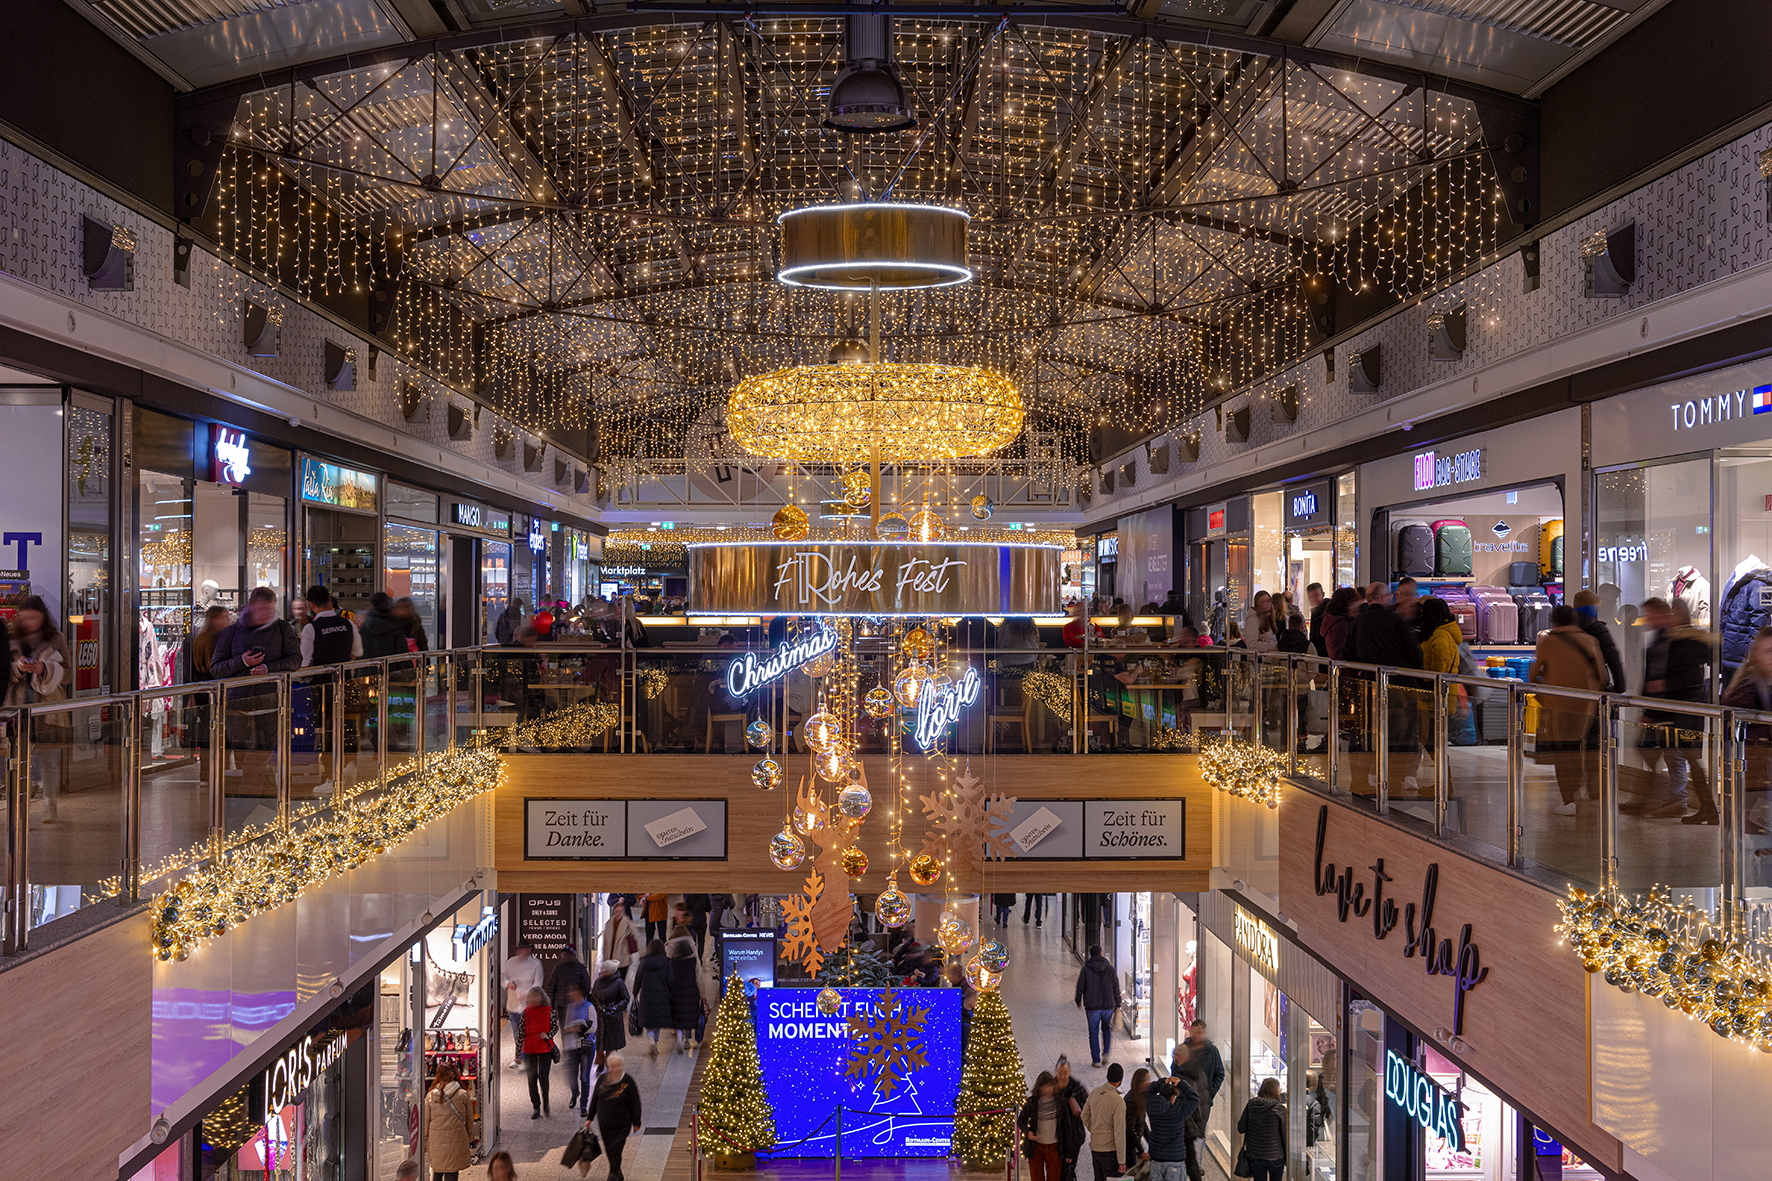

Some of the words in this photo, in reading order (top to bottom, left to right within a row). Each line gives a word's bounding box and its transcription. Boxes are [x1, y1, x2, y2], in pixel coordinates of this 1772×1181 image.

[1671, 389, 1746, 430] TOMMY
[1414, 451, 1435, 491] FILOU
[458, 503, 480, 527] MANGO
[1293, 491, 1316, 519] BONITA
[1474, 541, 1530, 552] travelite
[600, 565, 646, 577] Marktplatz
[896, 556, 967, 601] Fest
[321, 625, 348, 635] SERVICE
[78, 640, 99, 669] LEGO
[729, 628, 837, 697] Christmas
[545, 811, 578, 826] Zeit
[582, 810, 609, 826] für
[1103, 811, 1136, 826] Zeit
[1141, 810, 1167, 826] für
[545, 831, 605, 847] Danke.
[1100, 831, 1168, 847] Schönes.
[1314, 805, 1371, 922] love
[1369, 858, 1399, 940] to
[1404, 863, 1489, 1036] shop
[745, 949, 764, 957] Handys
[1234, 912, 1275, 969] PANDORA
[316, 1029, 348, 1077] PARFUM
[264, 1035, 312, 1124] LORIS
[1385, 1049, 1460, 1153] DOUGLAS
